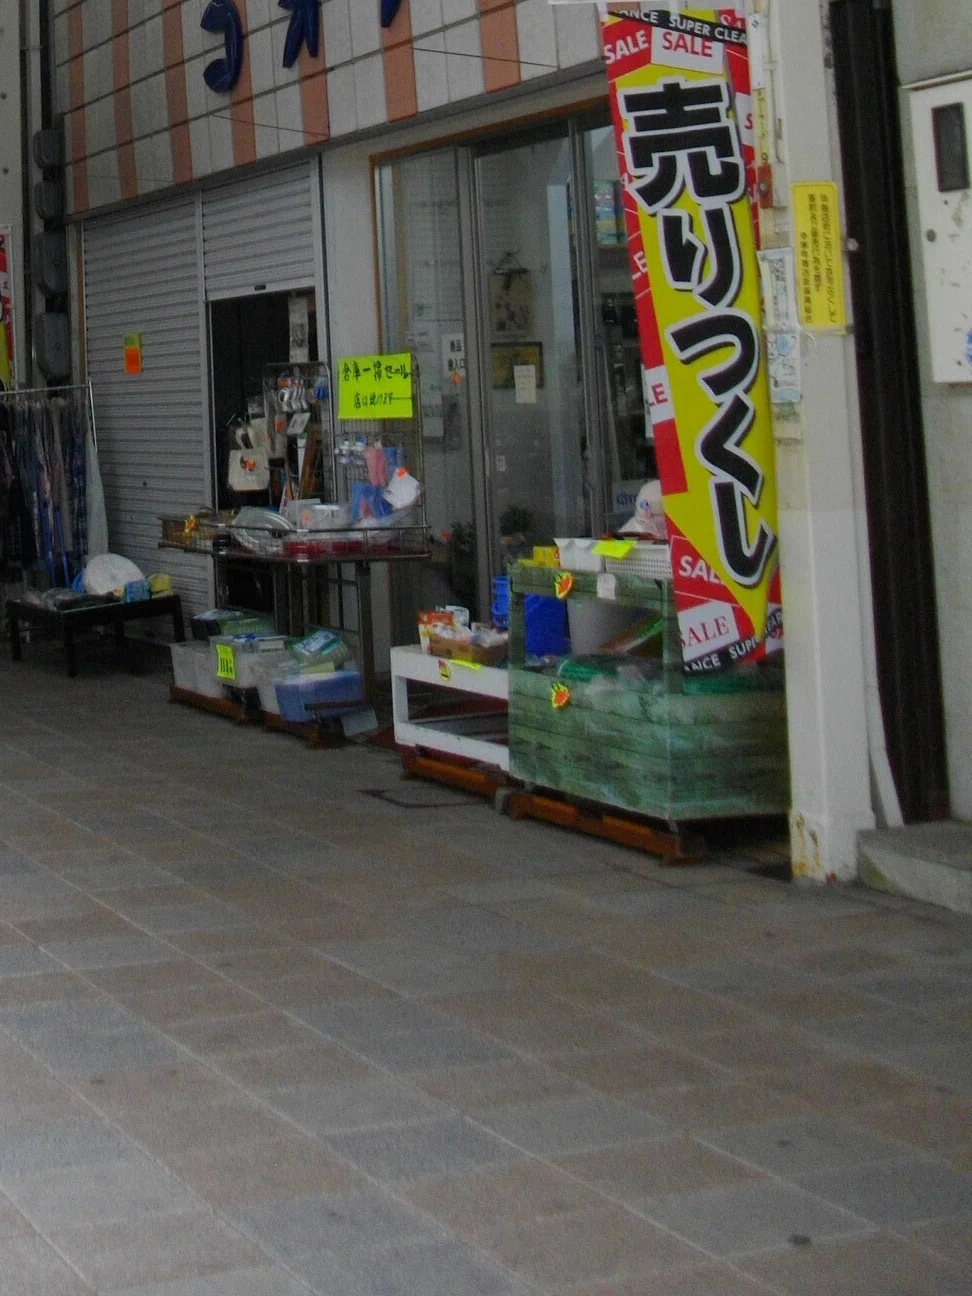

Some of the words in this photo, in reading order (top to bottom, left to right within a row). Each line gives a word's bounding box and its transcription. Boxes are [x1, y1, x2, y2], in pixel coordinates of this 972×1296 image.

[668, 16, 711, 36] SUPER
[604, 29, 649, 65] SALE
[662, 31, 713, 57] SALE
[622, 80, 776, 584] 売りつくし
